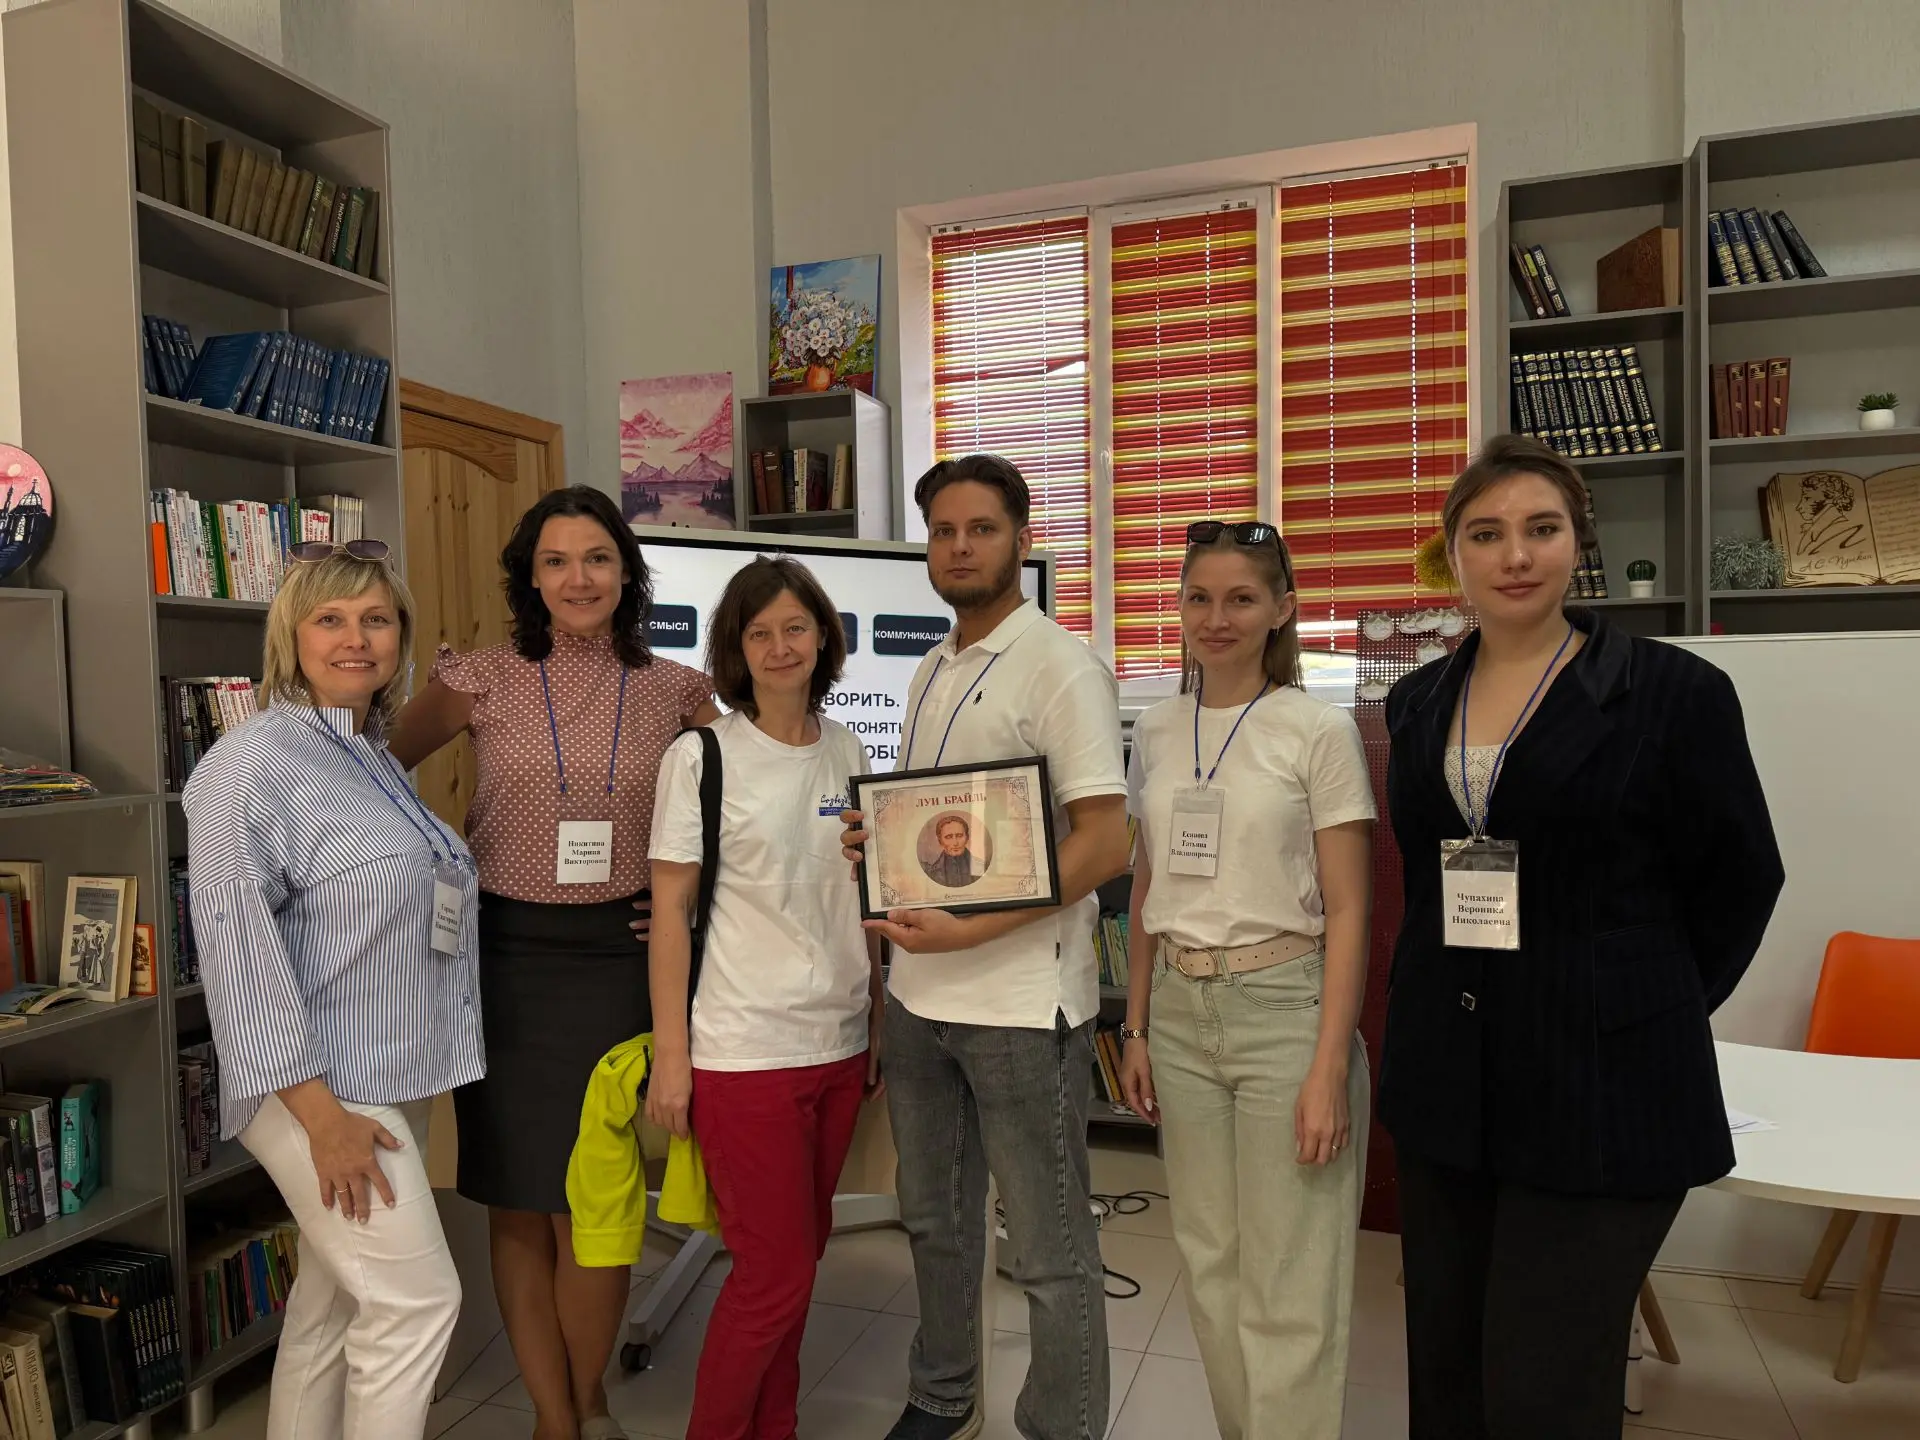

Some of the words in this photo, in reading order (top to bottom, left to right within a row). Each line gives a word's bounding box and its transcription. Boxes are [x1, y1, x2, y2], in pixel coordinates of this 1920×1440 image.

[649, 620, 689, 631] СМЫСЛ
[824, 692, 900, 708] ВОРИТЬ.
[915, 797, 939, 808] ЛУИ
[1457, 893, 1505, 903] Чупахина
[1458, 904, 1505, 915] Вероника
[1452, 915, 1511, 926] Николаевна
